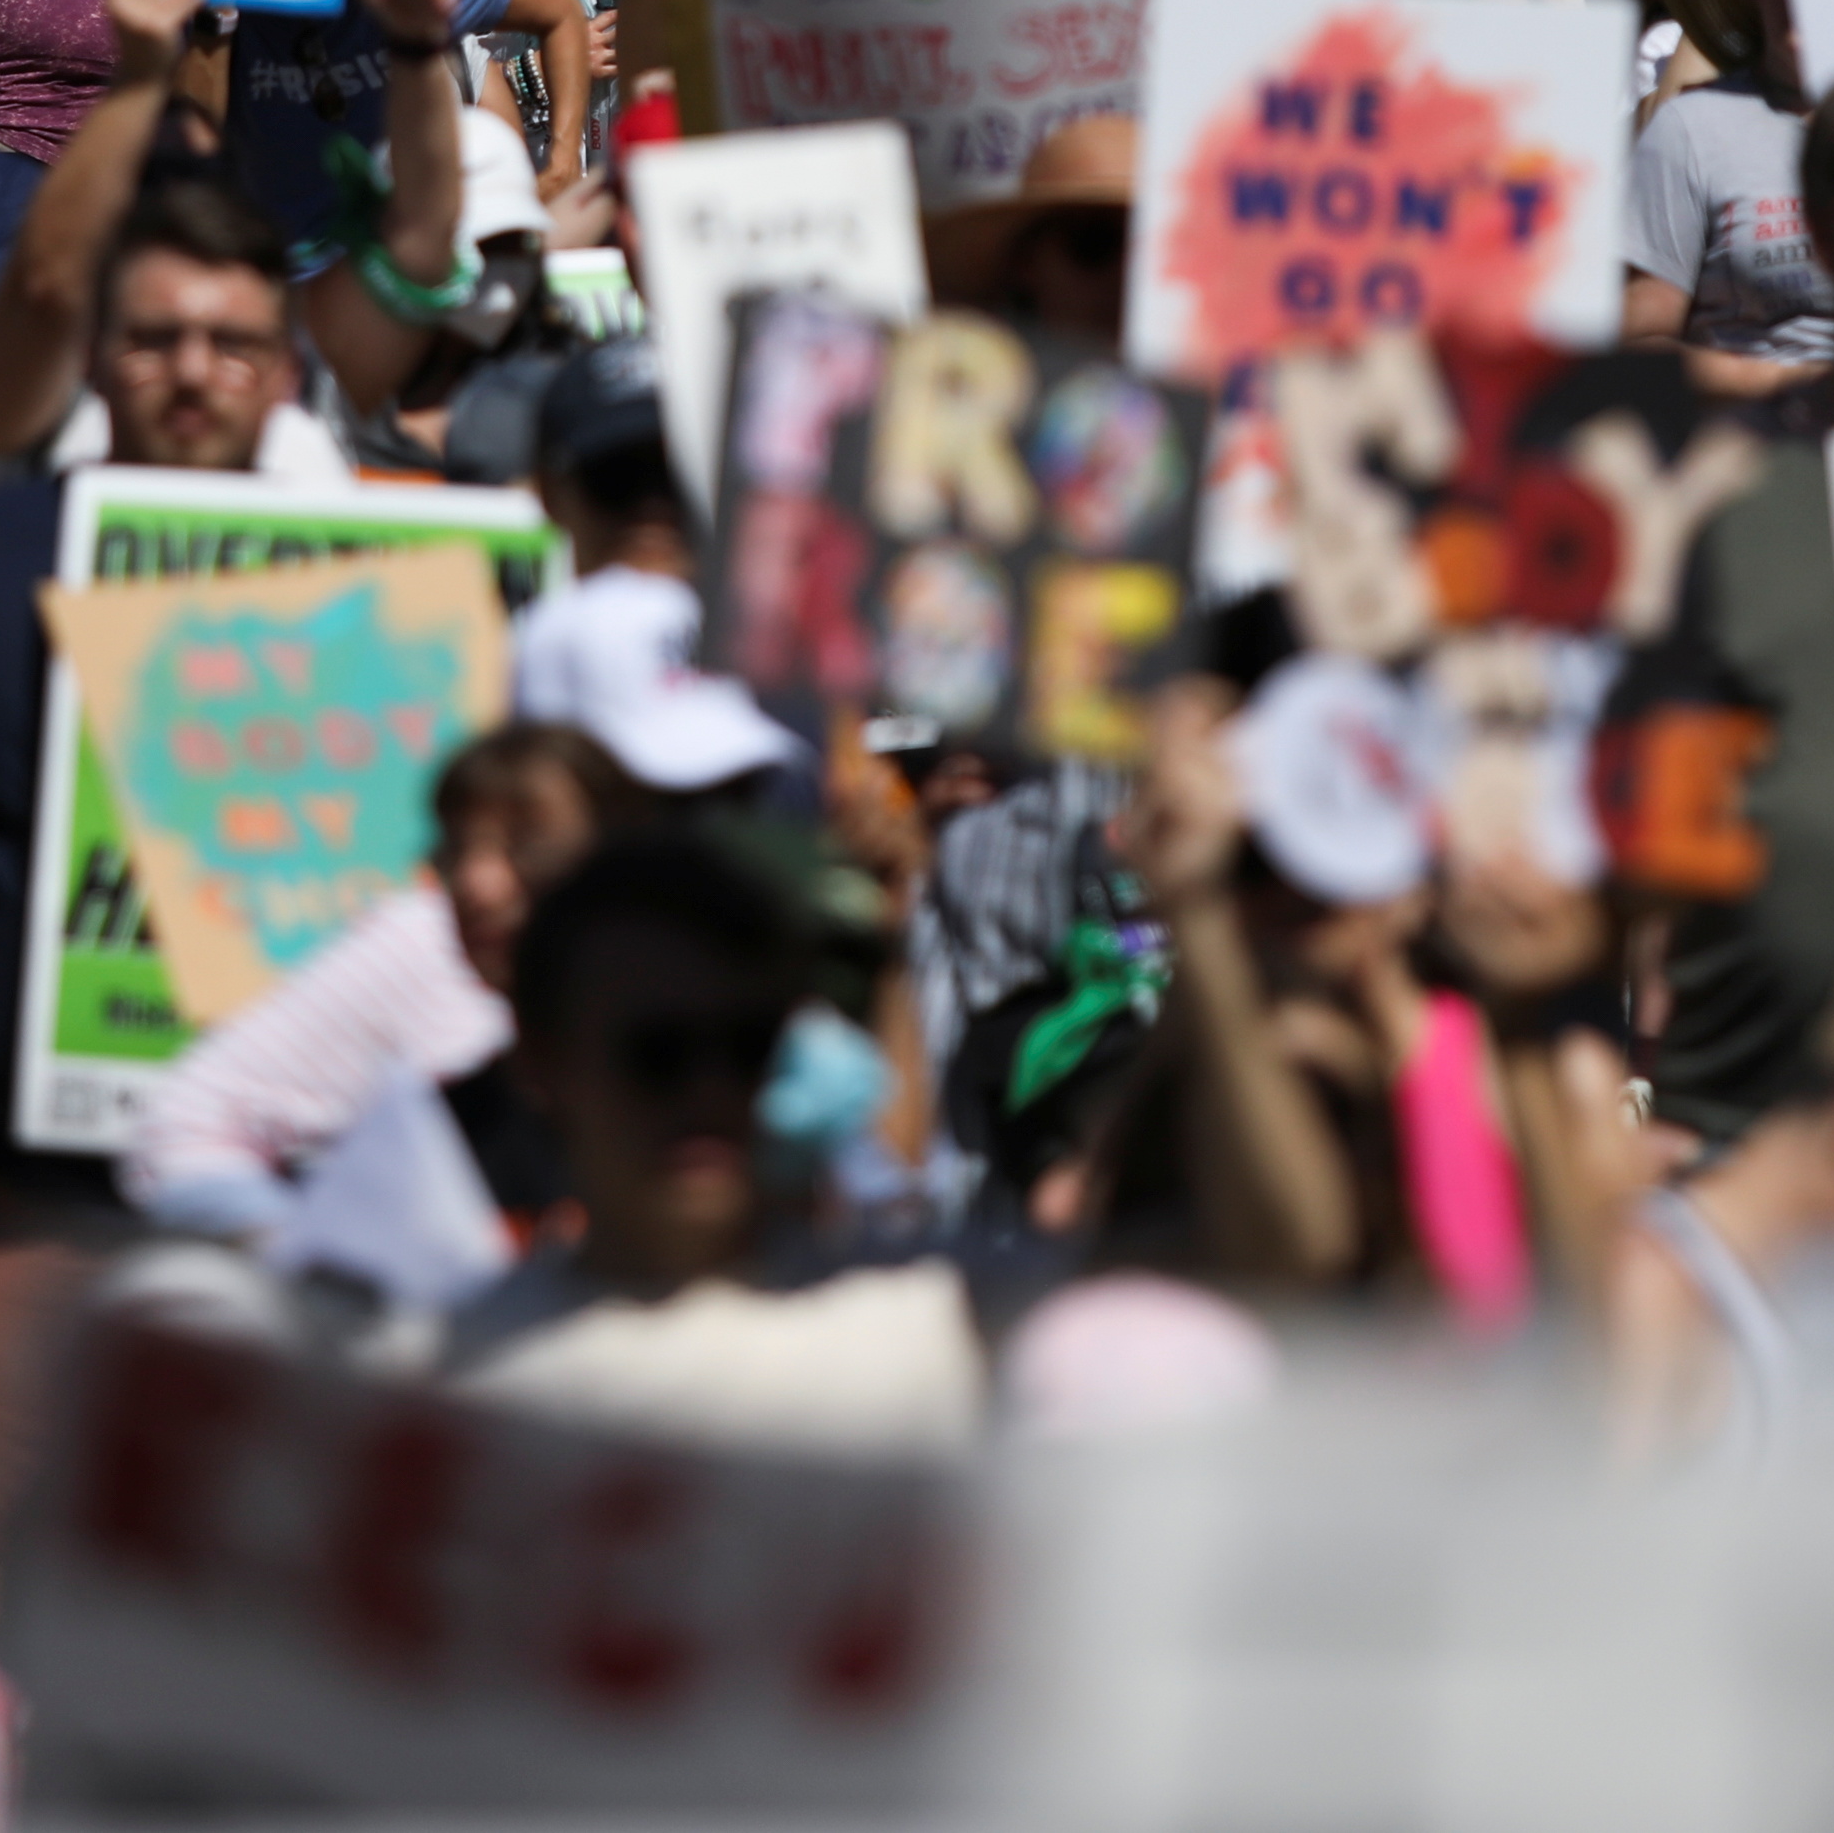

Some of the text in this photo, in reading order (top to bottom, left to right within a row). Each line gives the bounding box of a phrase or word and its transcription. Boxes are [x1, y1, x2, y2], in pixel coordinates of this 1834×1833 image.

[1254, 74, 1405, 143] WE
[1227, 162, 1575, 253] WON'T
[1274, 254, 1431, 336] GO
